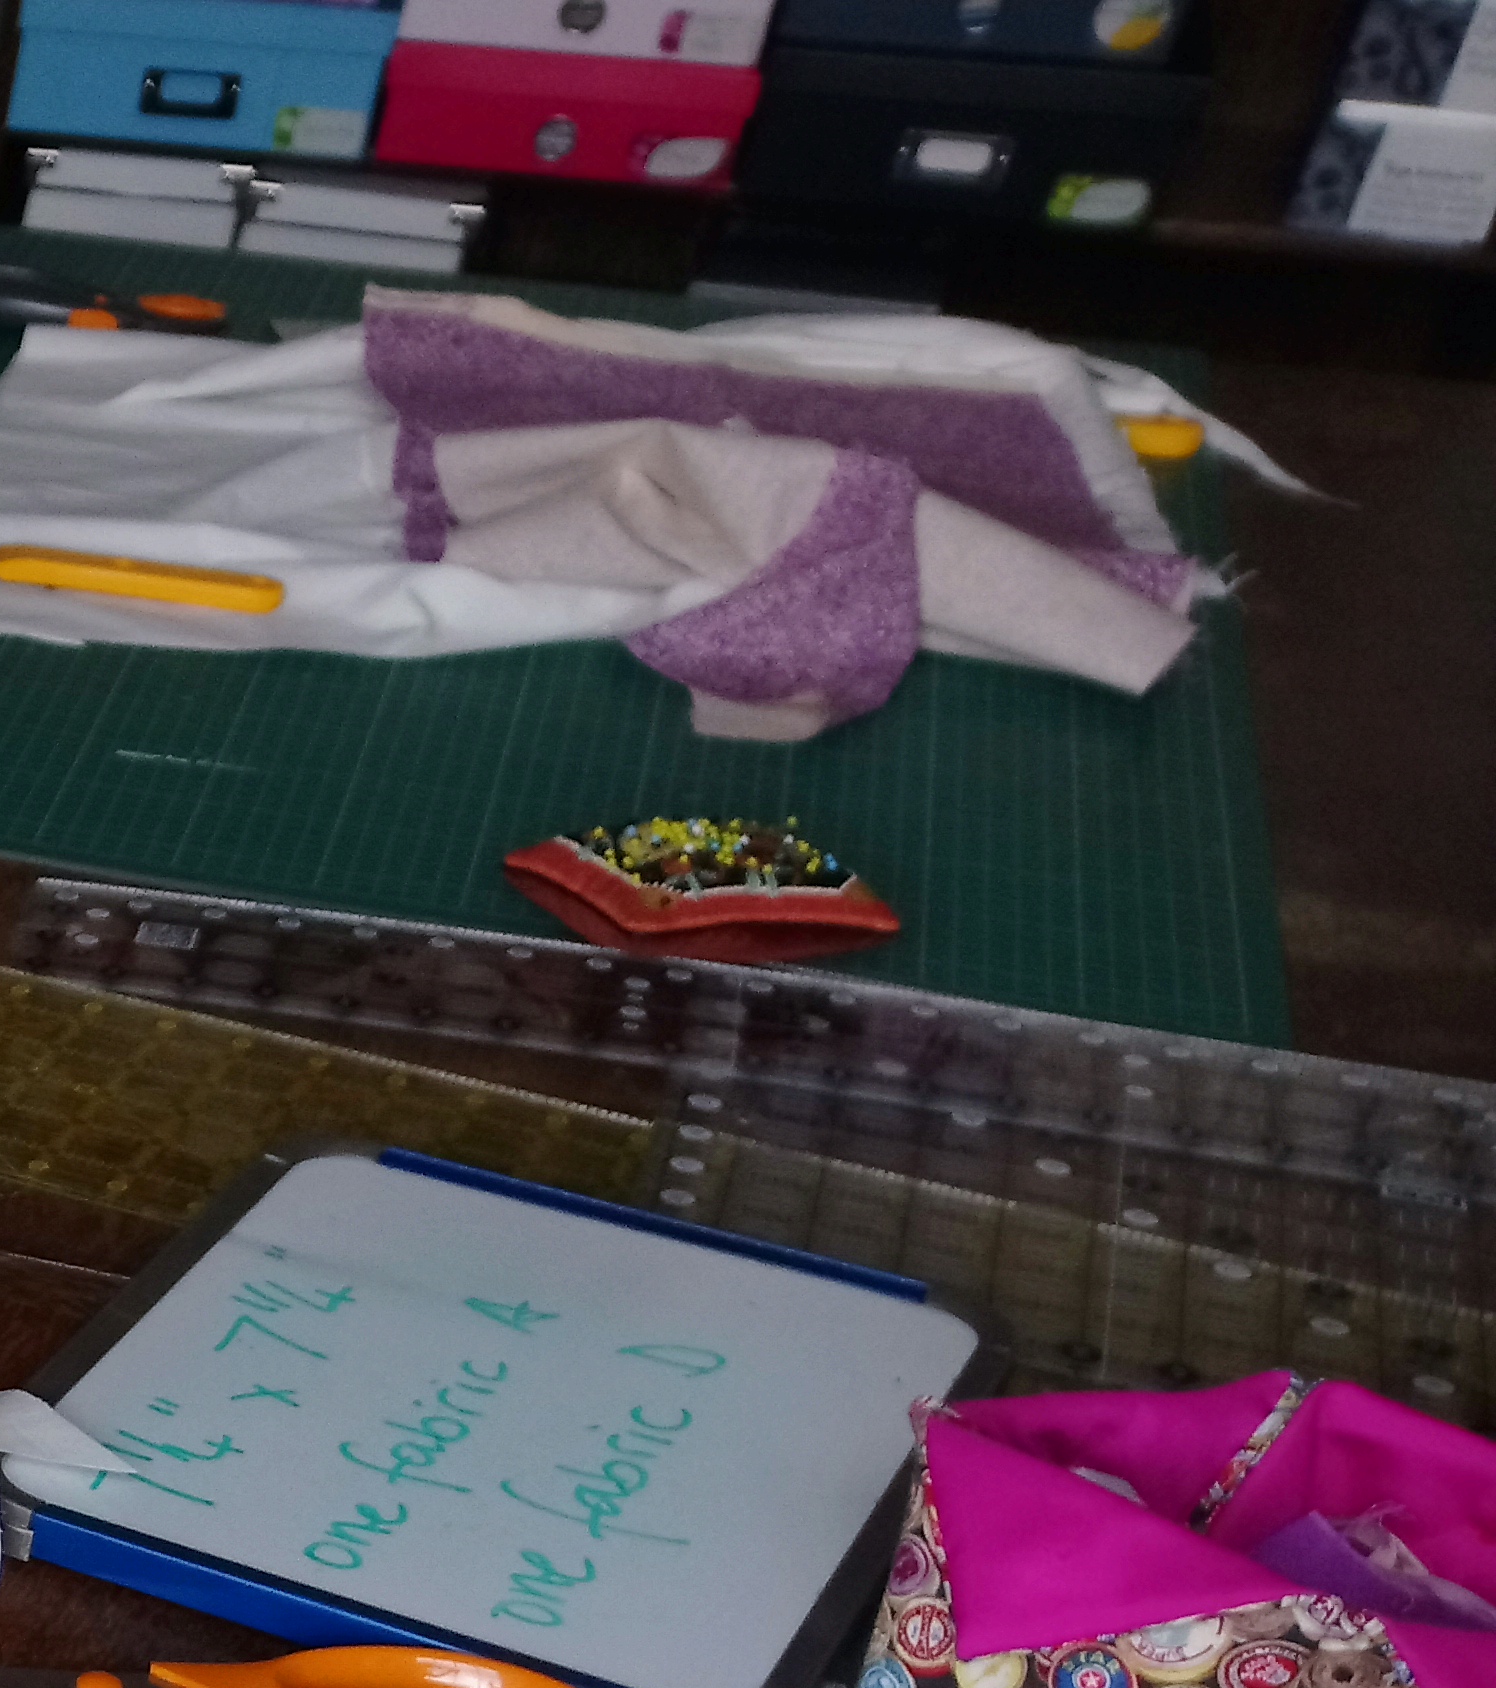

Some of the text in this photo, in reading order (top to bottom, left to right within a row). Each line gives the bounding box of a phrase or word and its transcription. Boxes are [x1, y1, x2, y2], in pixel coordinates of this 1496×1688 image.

[230, 1384, 300, 1407] x
[304, 1298, 559, 1570] one fabric A
[491, 1344, 725, 1628] one fabric D
